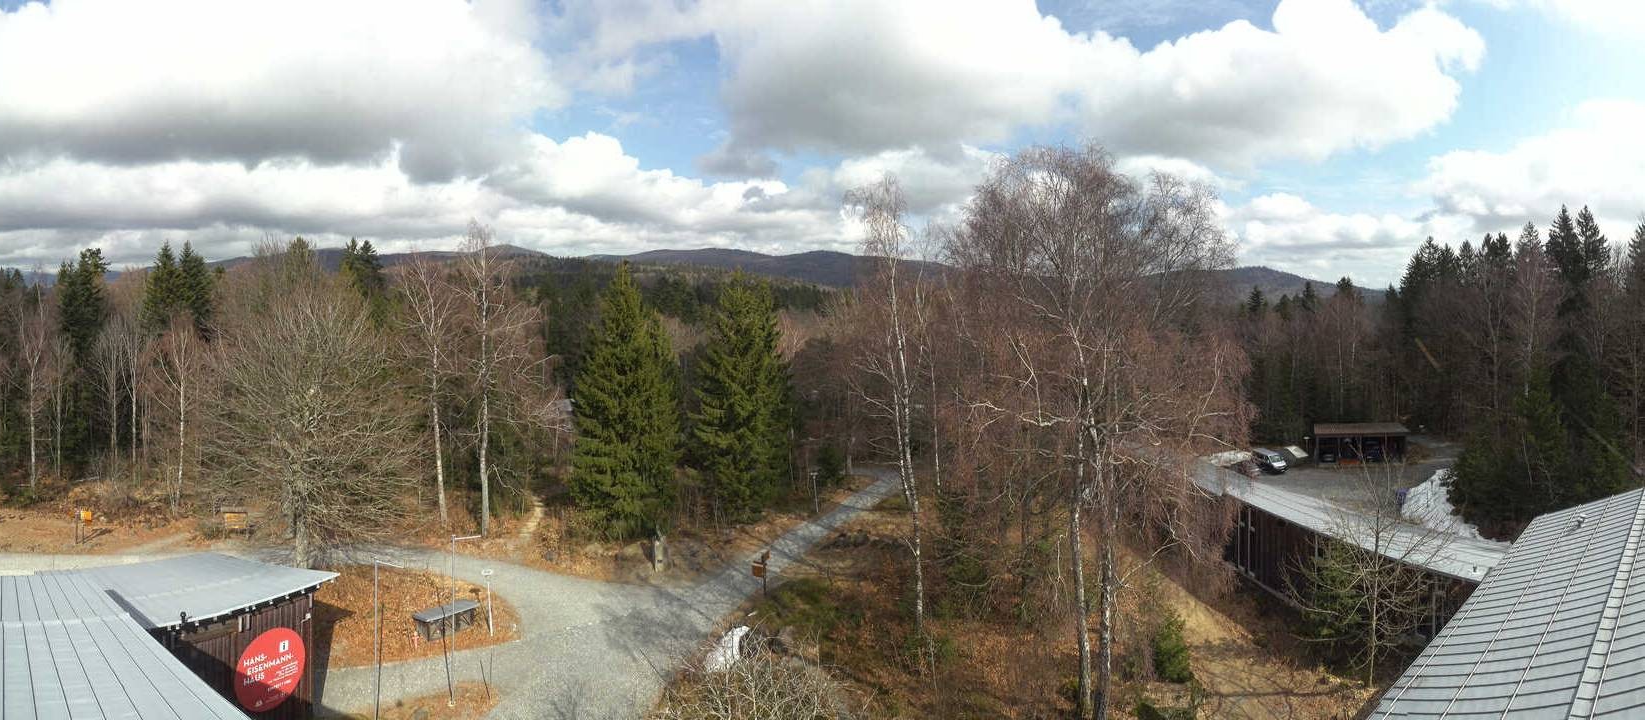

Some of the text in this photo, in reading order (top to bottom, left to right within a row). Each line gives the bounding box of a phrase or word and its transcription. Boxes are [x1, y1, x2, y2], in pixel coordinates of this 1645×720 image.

[243, 653, 267, 667] HANS-
[247, 653, 294, 676] EISENMANN-
[243, 672, 265, 687] HAUS
